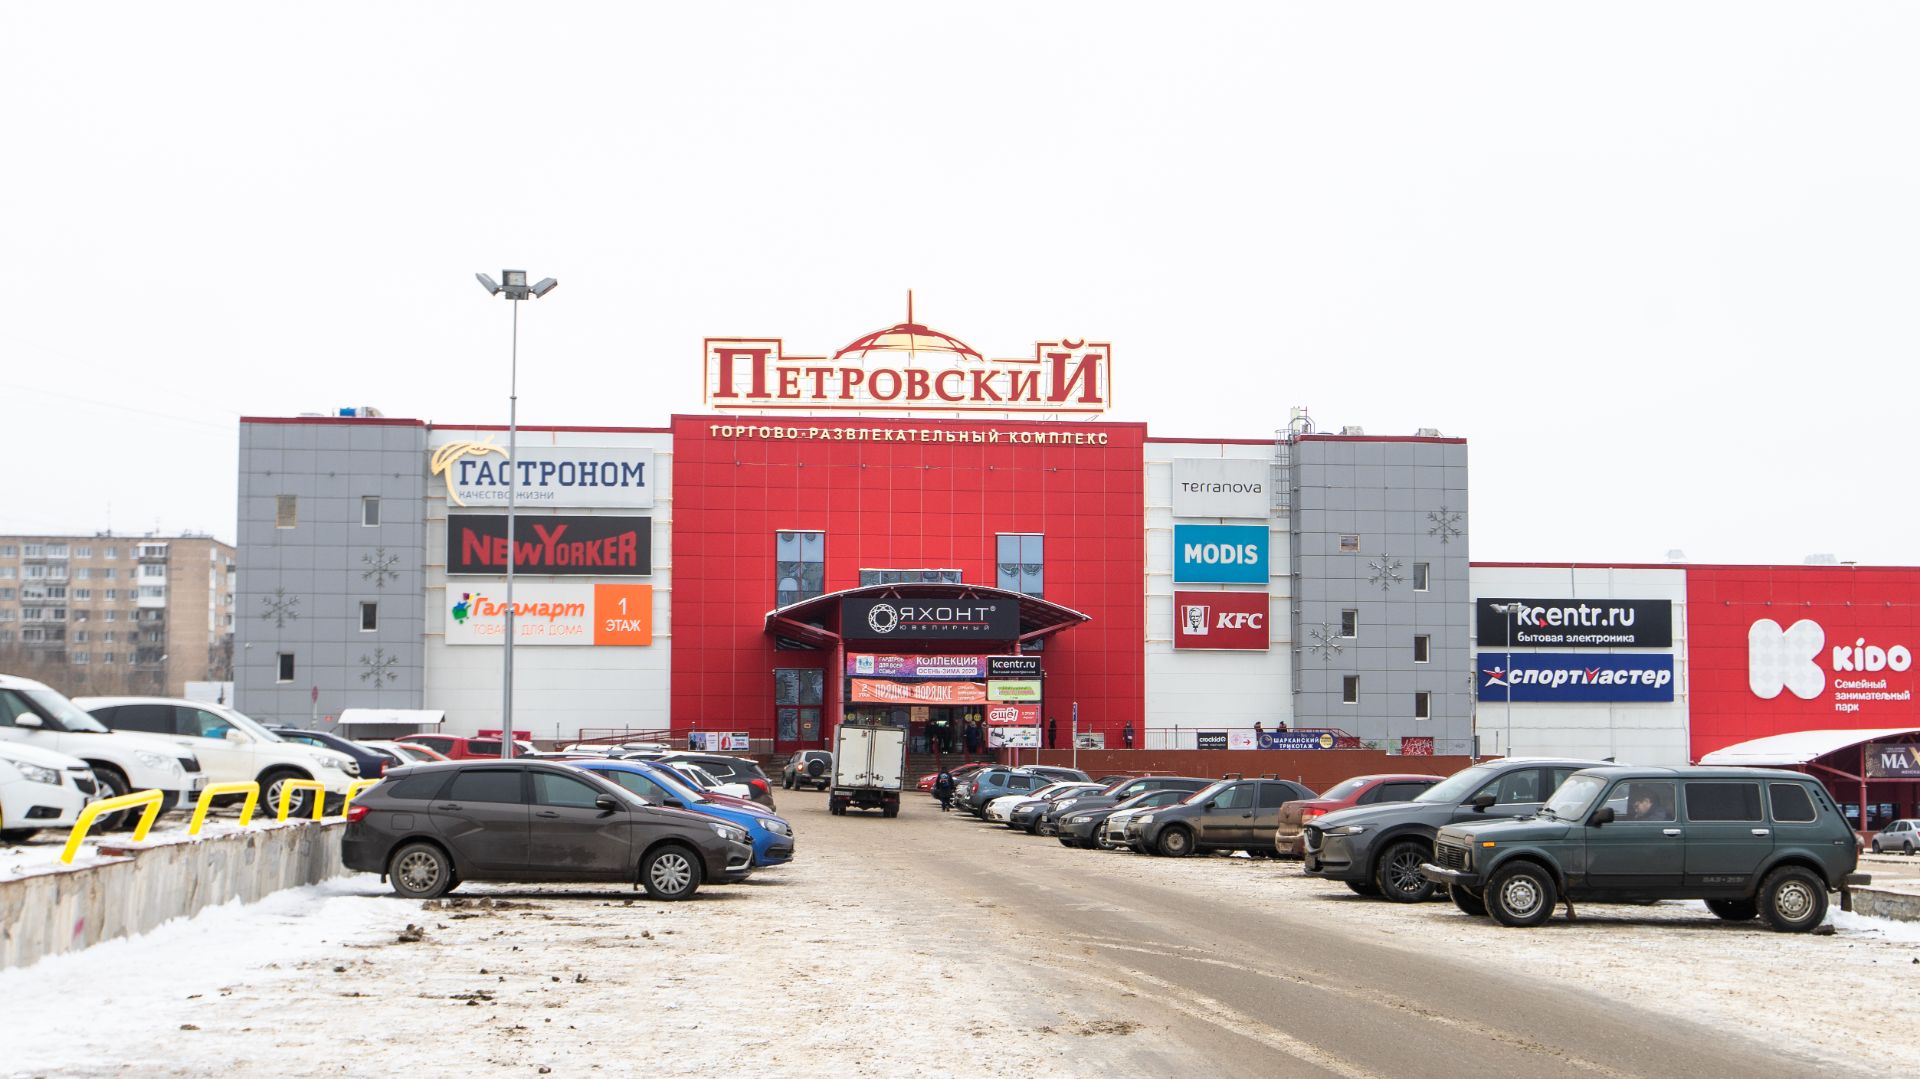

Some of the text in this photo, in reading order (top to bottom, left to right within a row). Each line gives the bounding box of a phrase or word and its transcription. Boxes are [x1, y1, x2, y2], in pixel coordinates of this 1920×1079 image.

[1010, 431, 1108, 445] КОМПЛЕКС
[459, 461, 646, 487] ГАСТРОНОМ
[516, 491, 555, 500] ЖИЗНИ
[1184, 543, 1258, 565] MODIS
[617, 597, 627, 615] 1
[1216, 612, 1263, 630] KFC
[1517, 603, 1635, 627] kcentr.ru
[521, 624, 545, 636] ДЛЯ
[549, 624, 583, 636] ДОМА
[605, 619, 641, 632] ЭТАЖ
[1517, 632, 1635, 645] бытовая электроника
[916, 656, 978, 667] КОЛЛЕКЦИЯ
[992, 659, 1036, 669] kcentr.ru
[1834, 677, 1887, 689] Семейный
[915, 685, 952, 701] ПОРЯДКЕ
[1834, 690, 1910, 700] занимательный
[1835, 703, 1860, 714] парк
